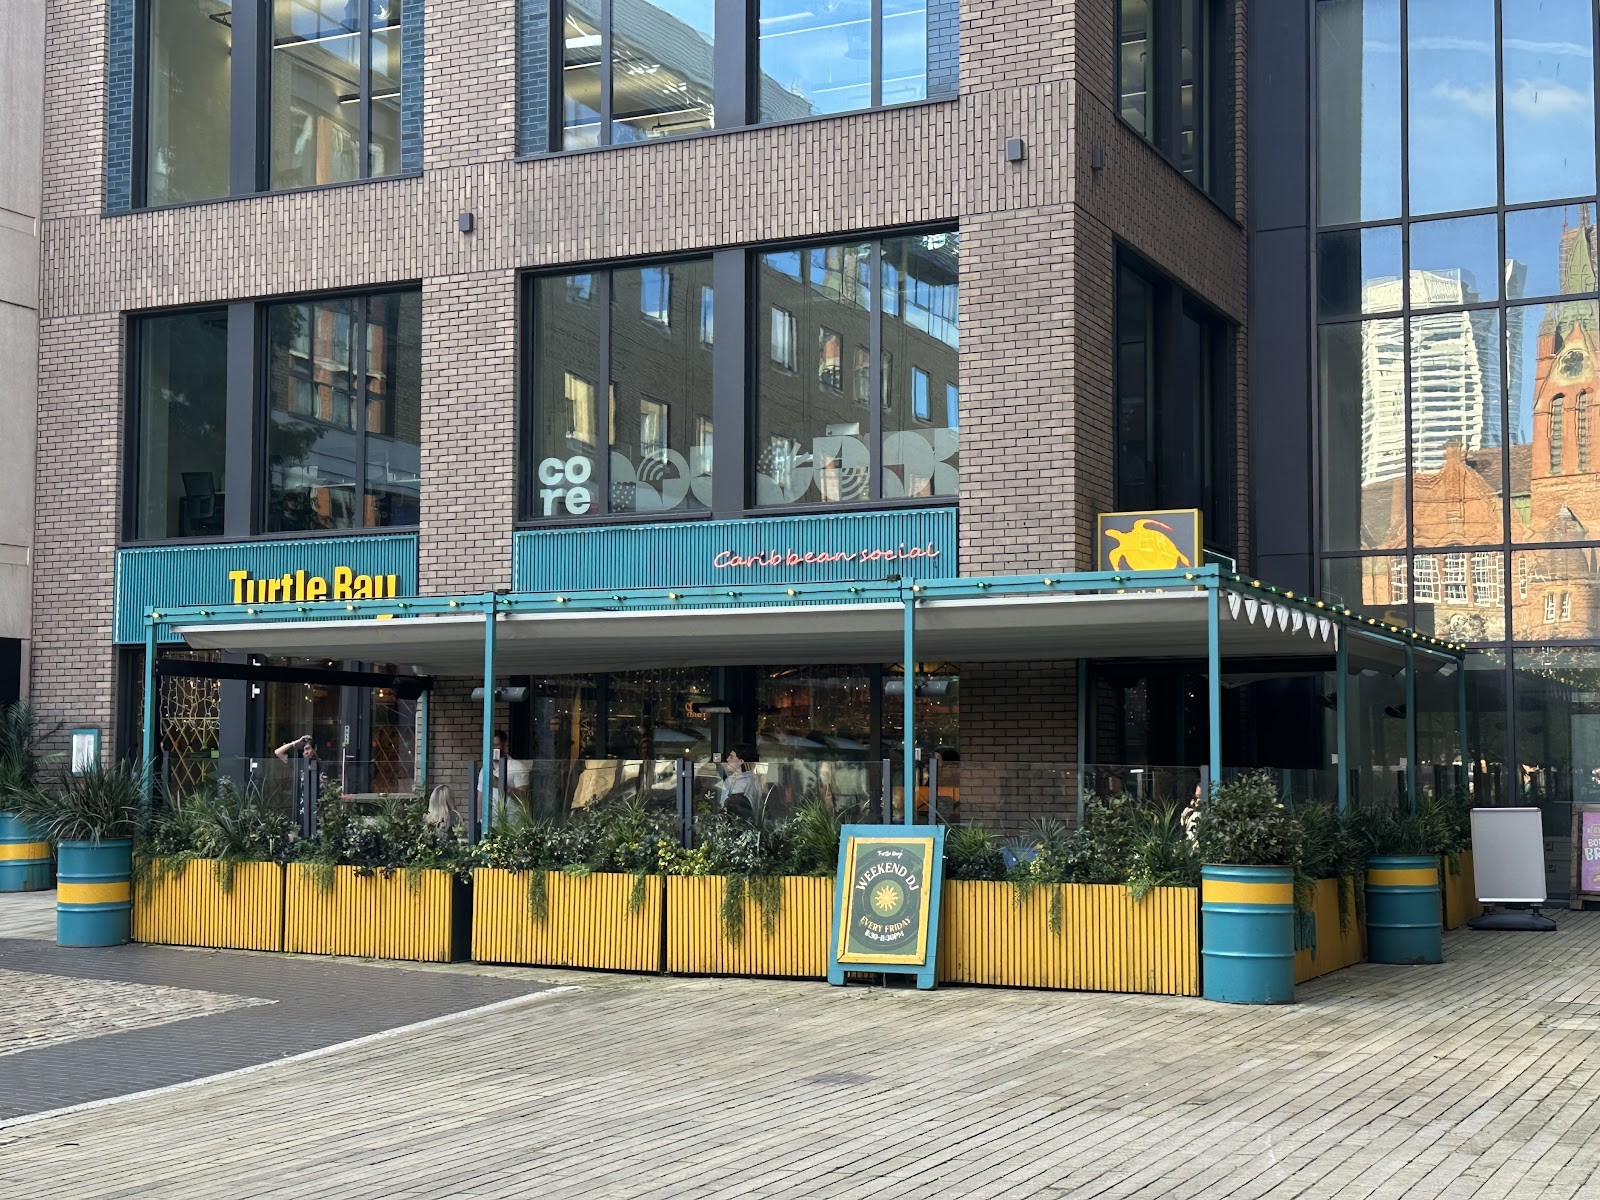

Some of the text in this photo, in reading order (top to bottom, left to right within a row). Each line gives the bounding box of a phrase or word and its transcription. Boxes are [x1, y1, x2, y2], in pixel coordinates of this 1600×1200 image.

[538, 455, 592, 486] co
[539, 486, 592, 516] re
[713, 541, 940, 568] Caribbean social
[228, 569, 328, 604] Turtle
[855, 862, 919, 890] WEEKEND DJ
[860, 915, 911, 933] EVERY FRIDAY
